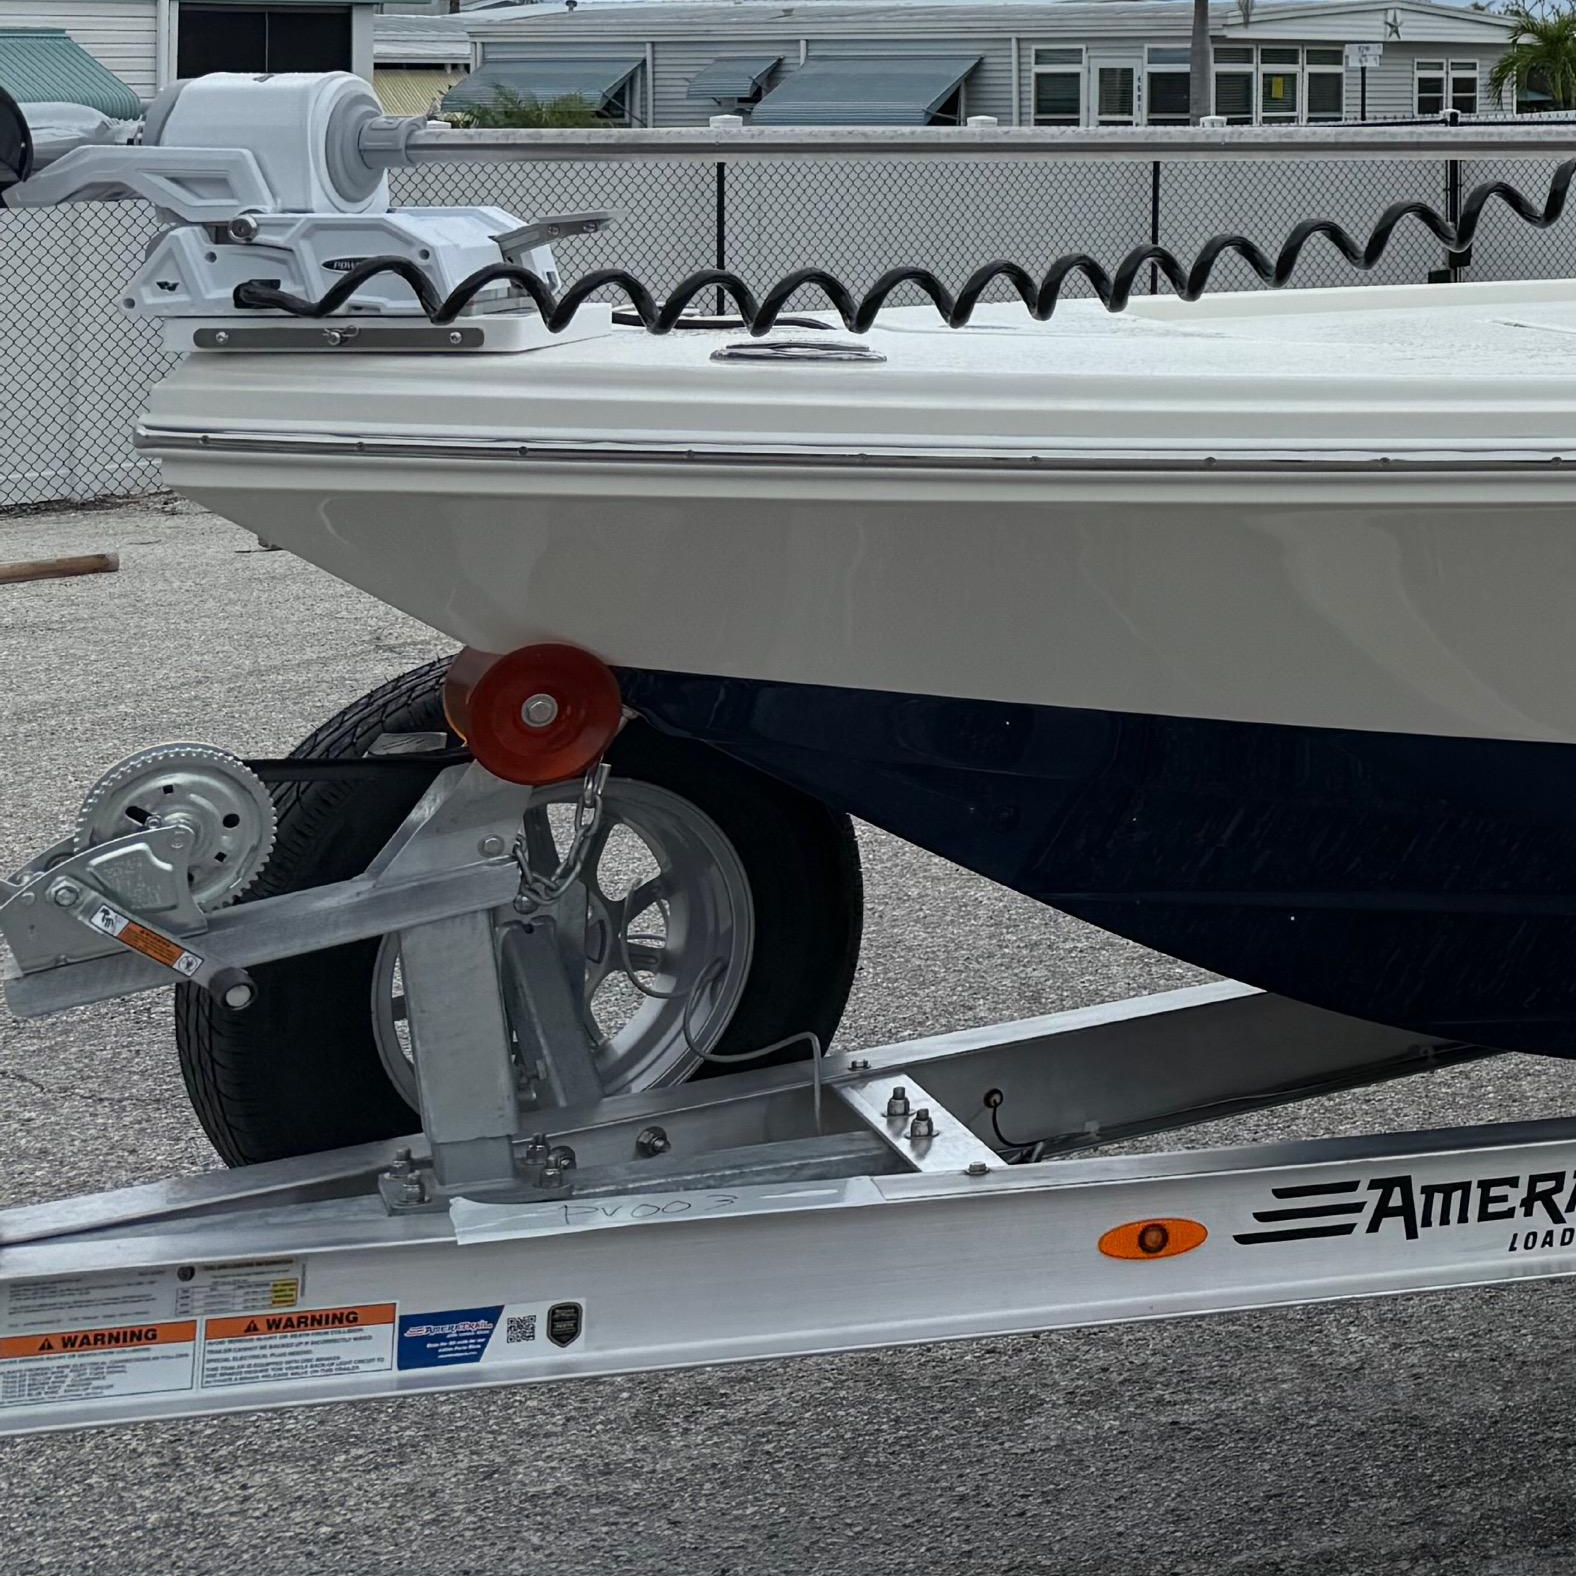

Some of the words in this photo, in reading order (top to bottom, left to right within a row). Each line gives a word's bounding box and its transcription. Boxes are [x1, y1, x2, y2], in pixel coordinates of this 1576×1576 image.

[1508, 1227, 1575, 1252] LOAD
[265, 1311, 359, 1331] WARNING
[61, 1328, 158, 1349] WARNING
